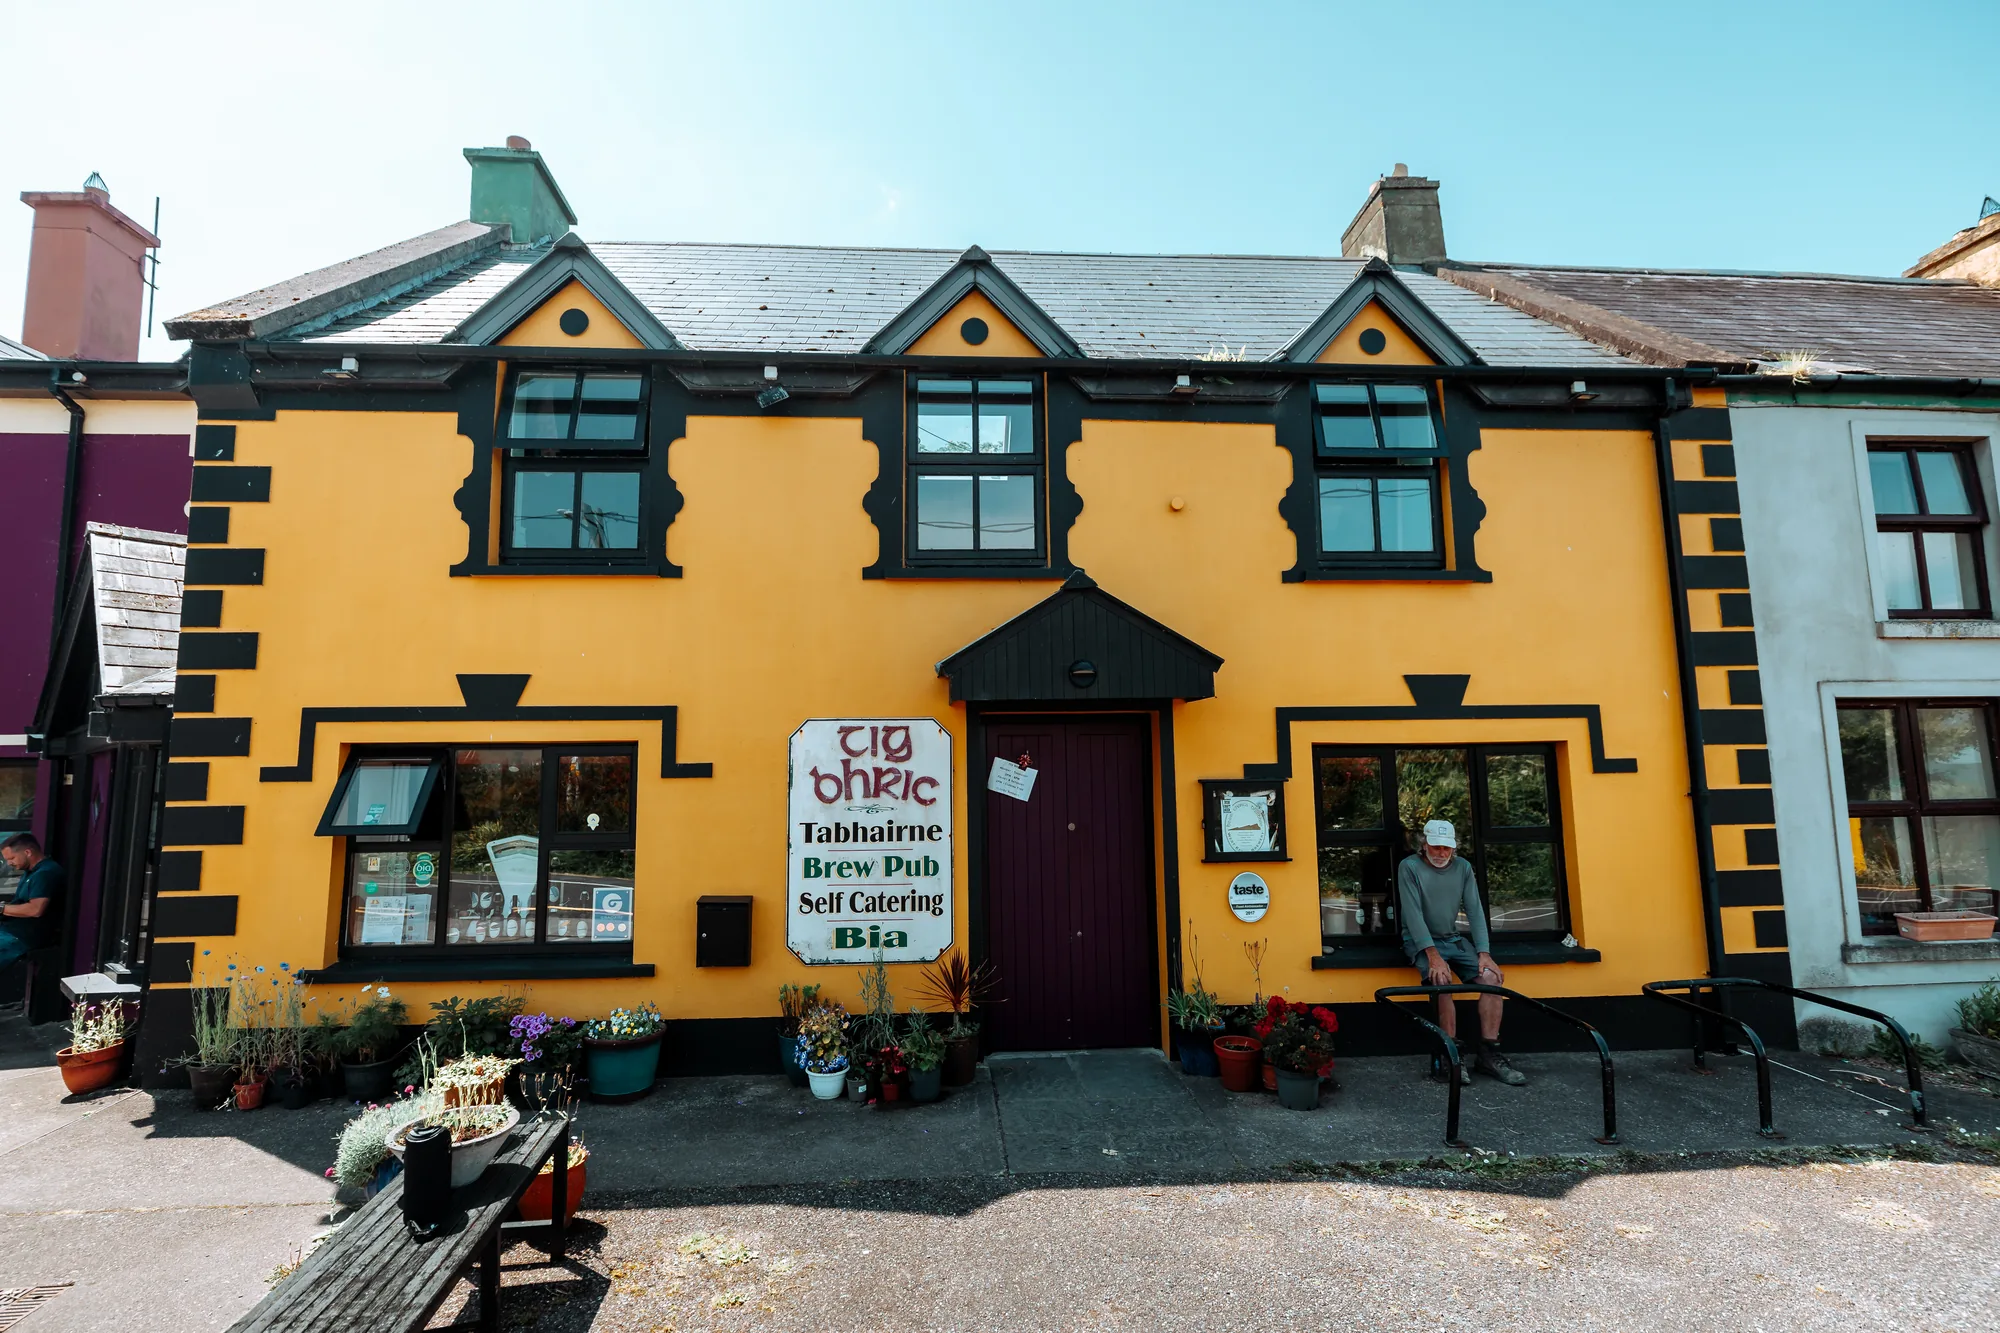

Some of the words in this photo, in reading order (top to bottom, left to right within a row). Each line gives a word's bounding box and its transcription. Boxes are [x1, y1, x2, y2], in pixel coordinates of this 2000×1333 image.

[799, 820, 943, 843] Tabhairne
[802, 857, 875, 879] Brew
[884, 855, 940, 877] Pub
[1233, 884, 1264, 895] taste
[798, 891, 844, 914] Self
[849, 889, 944, 917] Catering
[834, 925, 908, 949] Bia
